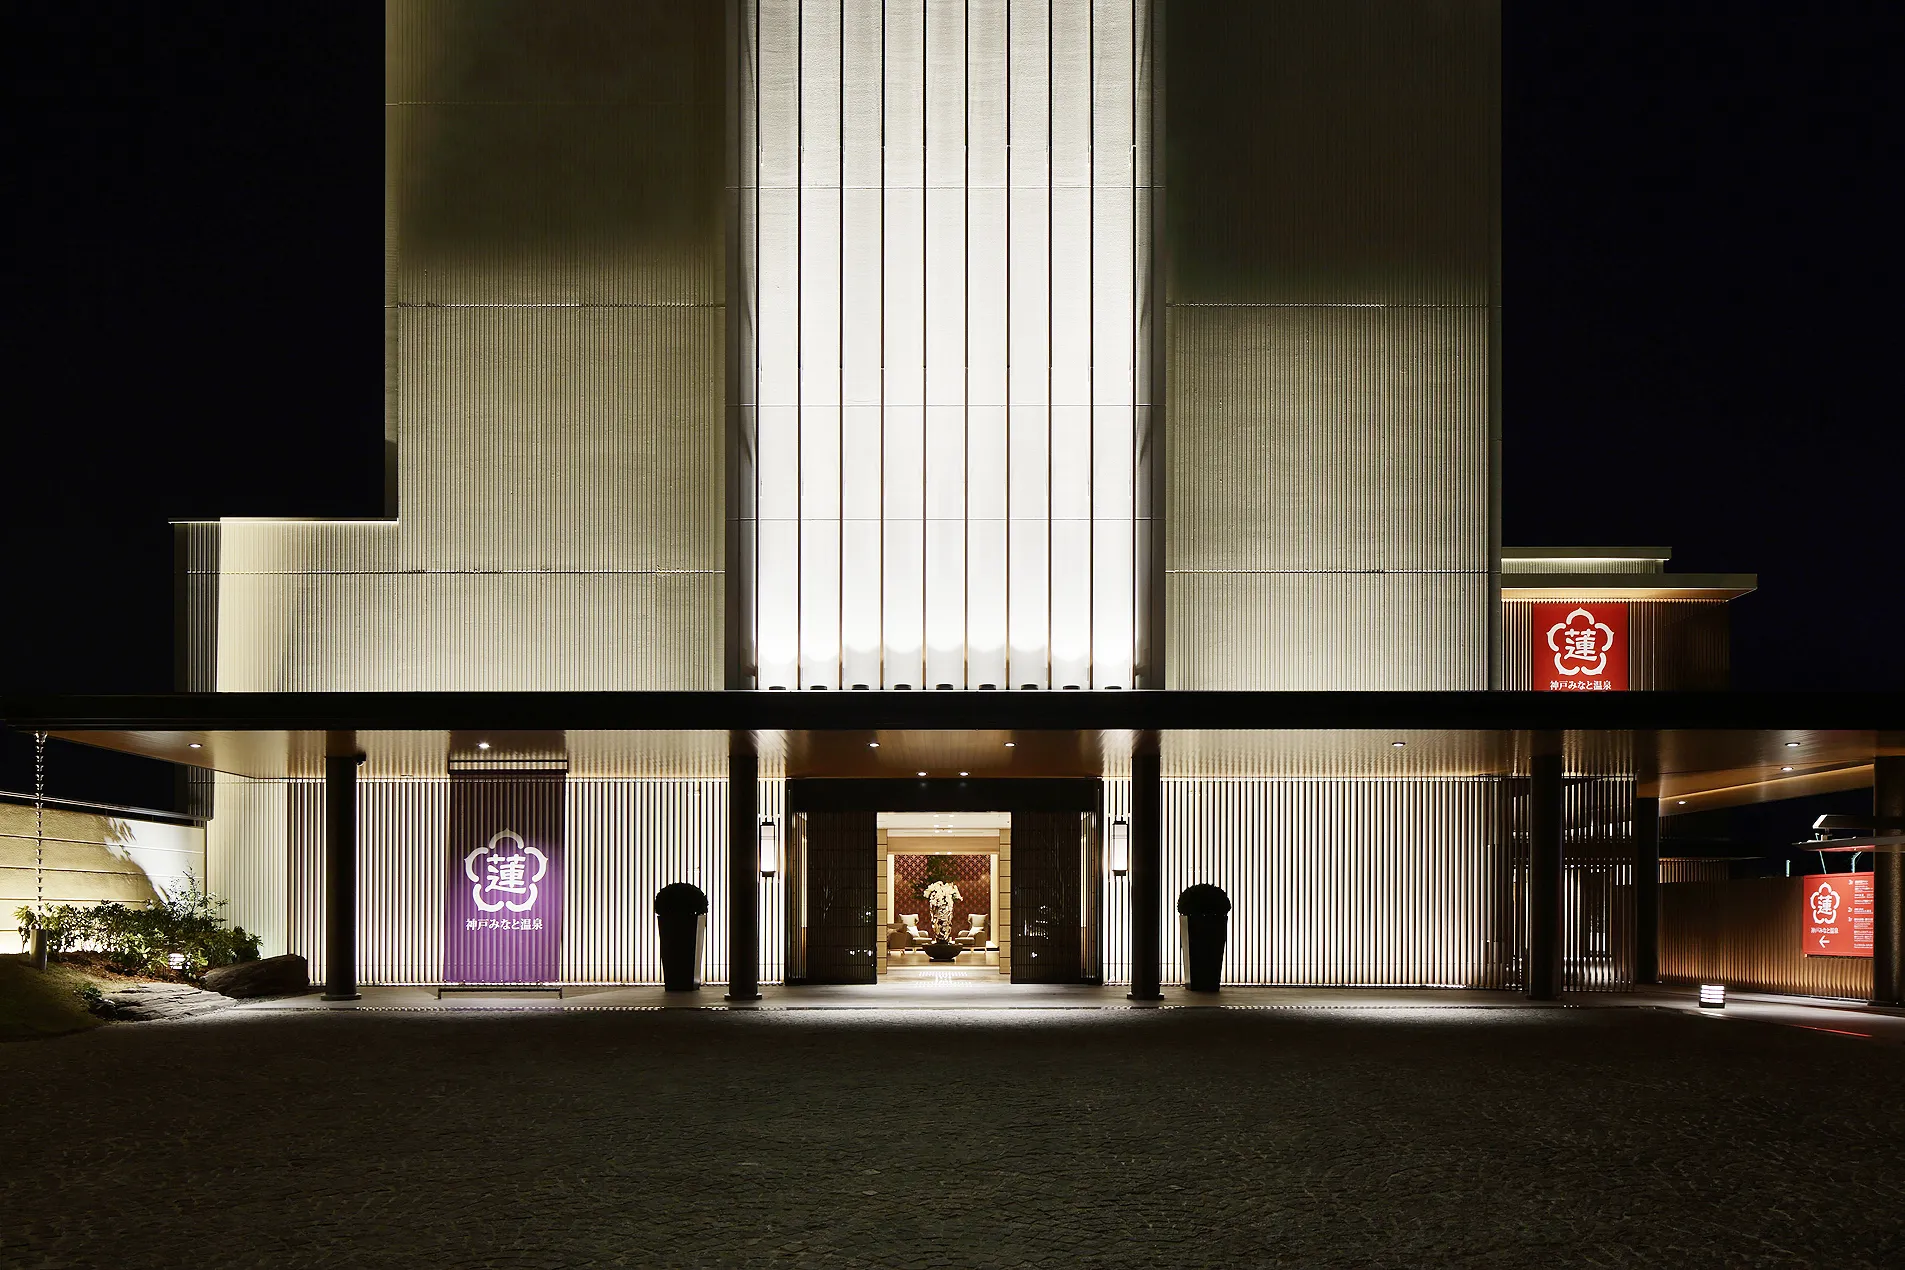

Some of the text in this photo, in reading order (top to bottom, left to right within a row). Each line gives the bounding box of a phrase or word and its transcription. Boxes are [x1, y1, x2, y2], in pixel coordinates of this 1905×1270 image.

[1564, 628, 1598, 662] 蓮
[1549, 680, 1612, 690] 神戸みなと温泉
[485, 854, 527, 894] 蓮
[465, 918, 543, 931] 神戸みなと温泉
